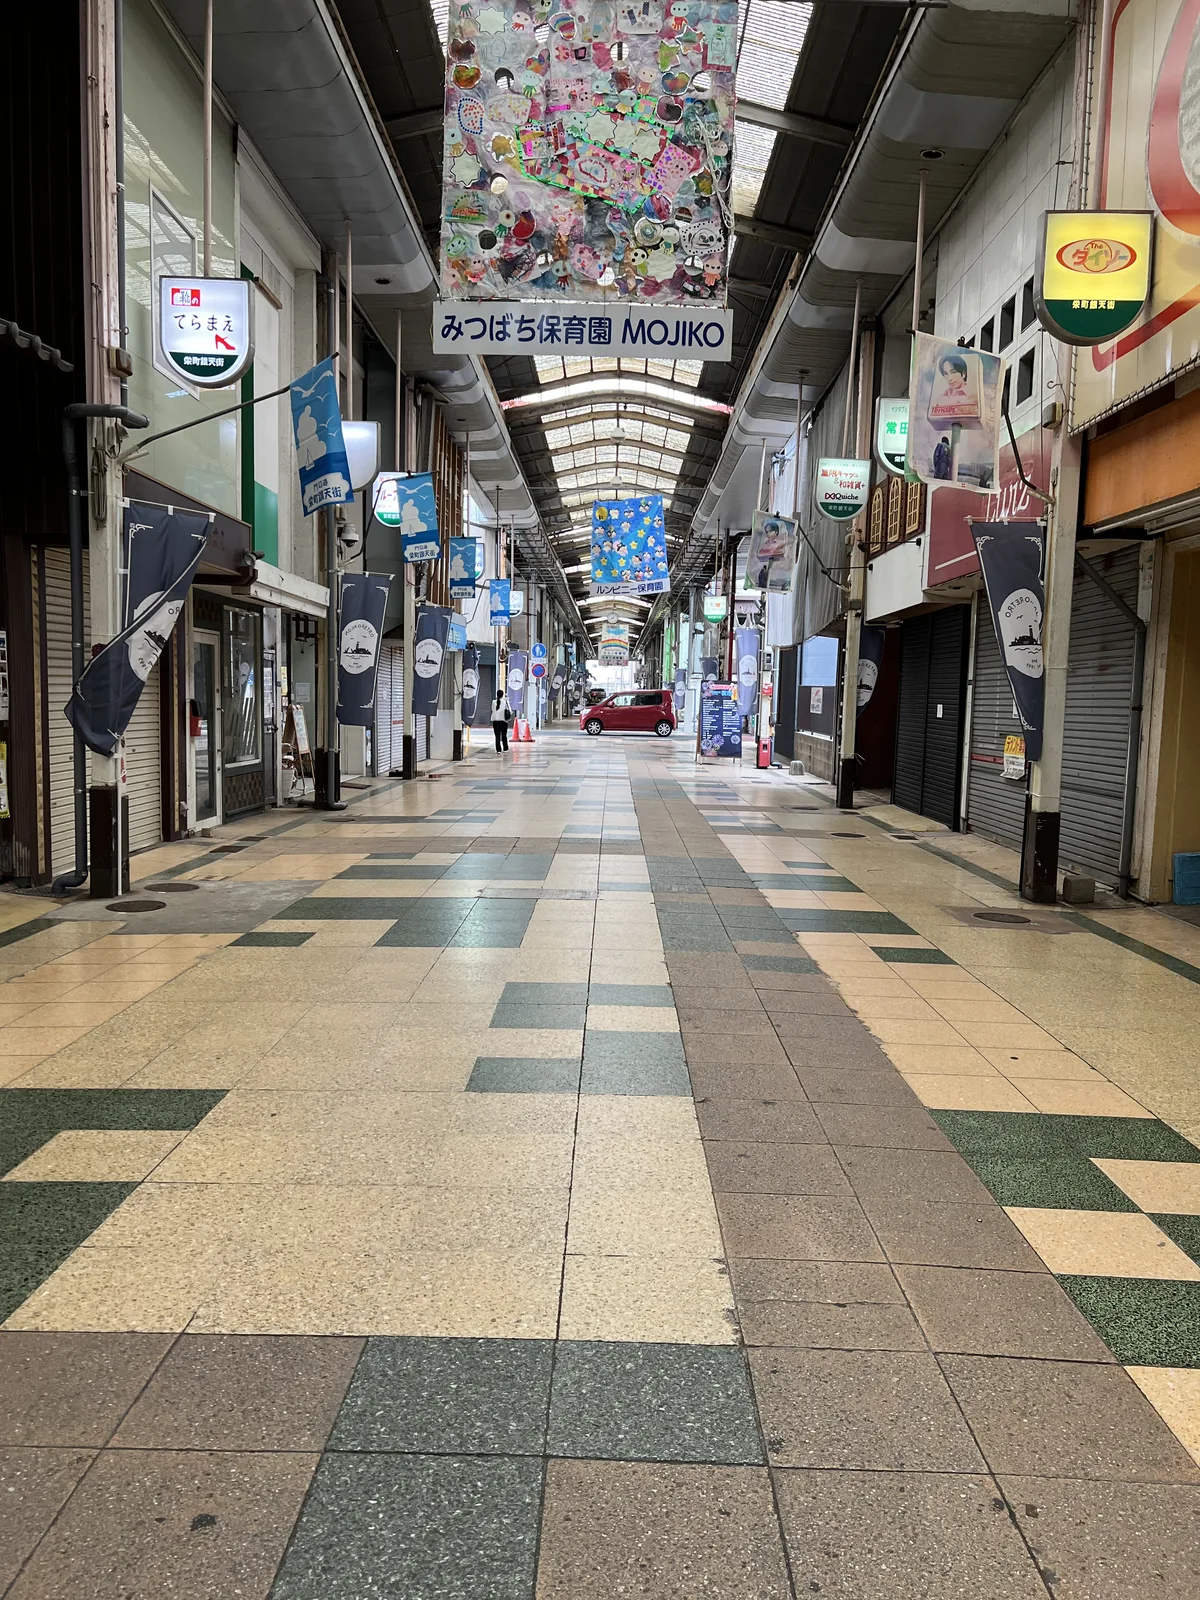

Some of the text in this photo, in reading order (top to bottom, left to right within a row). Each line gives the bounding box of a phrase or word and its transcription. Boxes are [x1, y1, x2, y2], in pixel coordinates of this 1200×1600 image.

[1072, 247, 1128, 266] ダイソー
[179, 290, 199, 305] 靴の
[173, 314, 234, 332] てらまえ
[441, 313, 725, 348] みつばち保育園 MOJIKO
[596, 581, 664, 594] ルンビニー保育園
